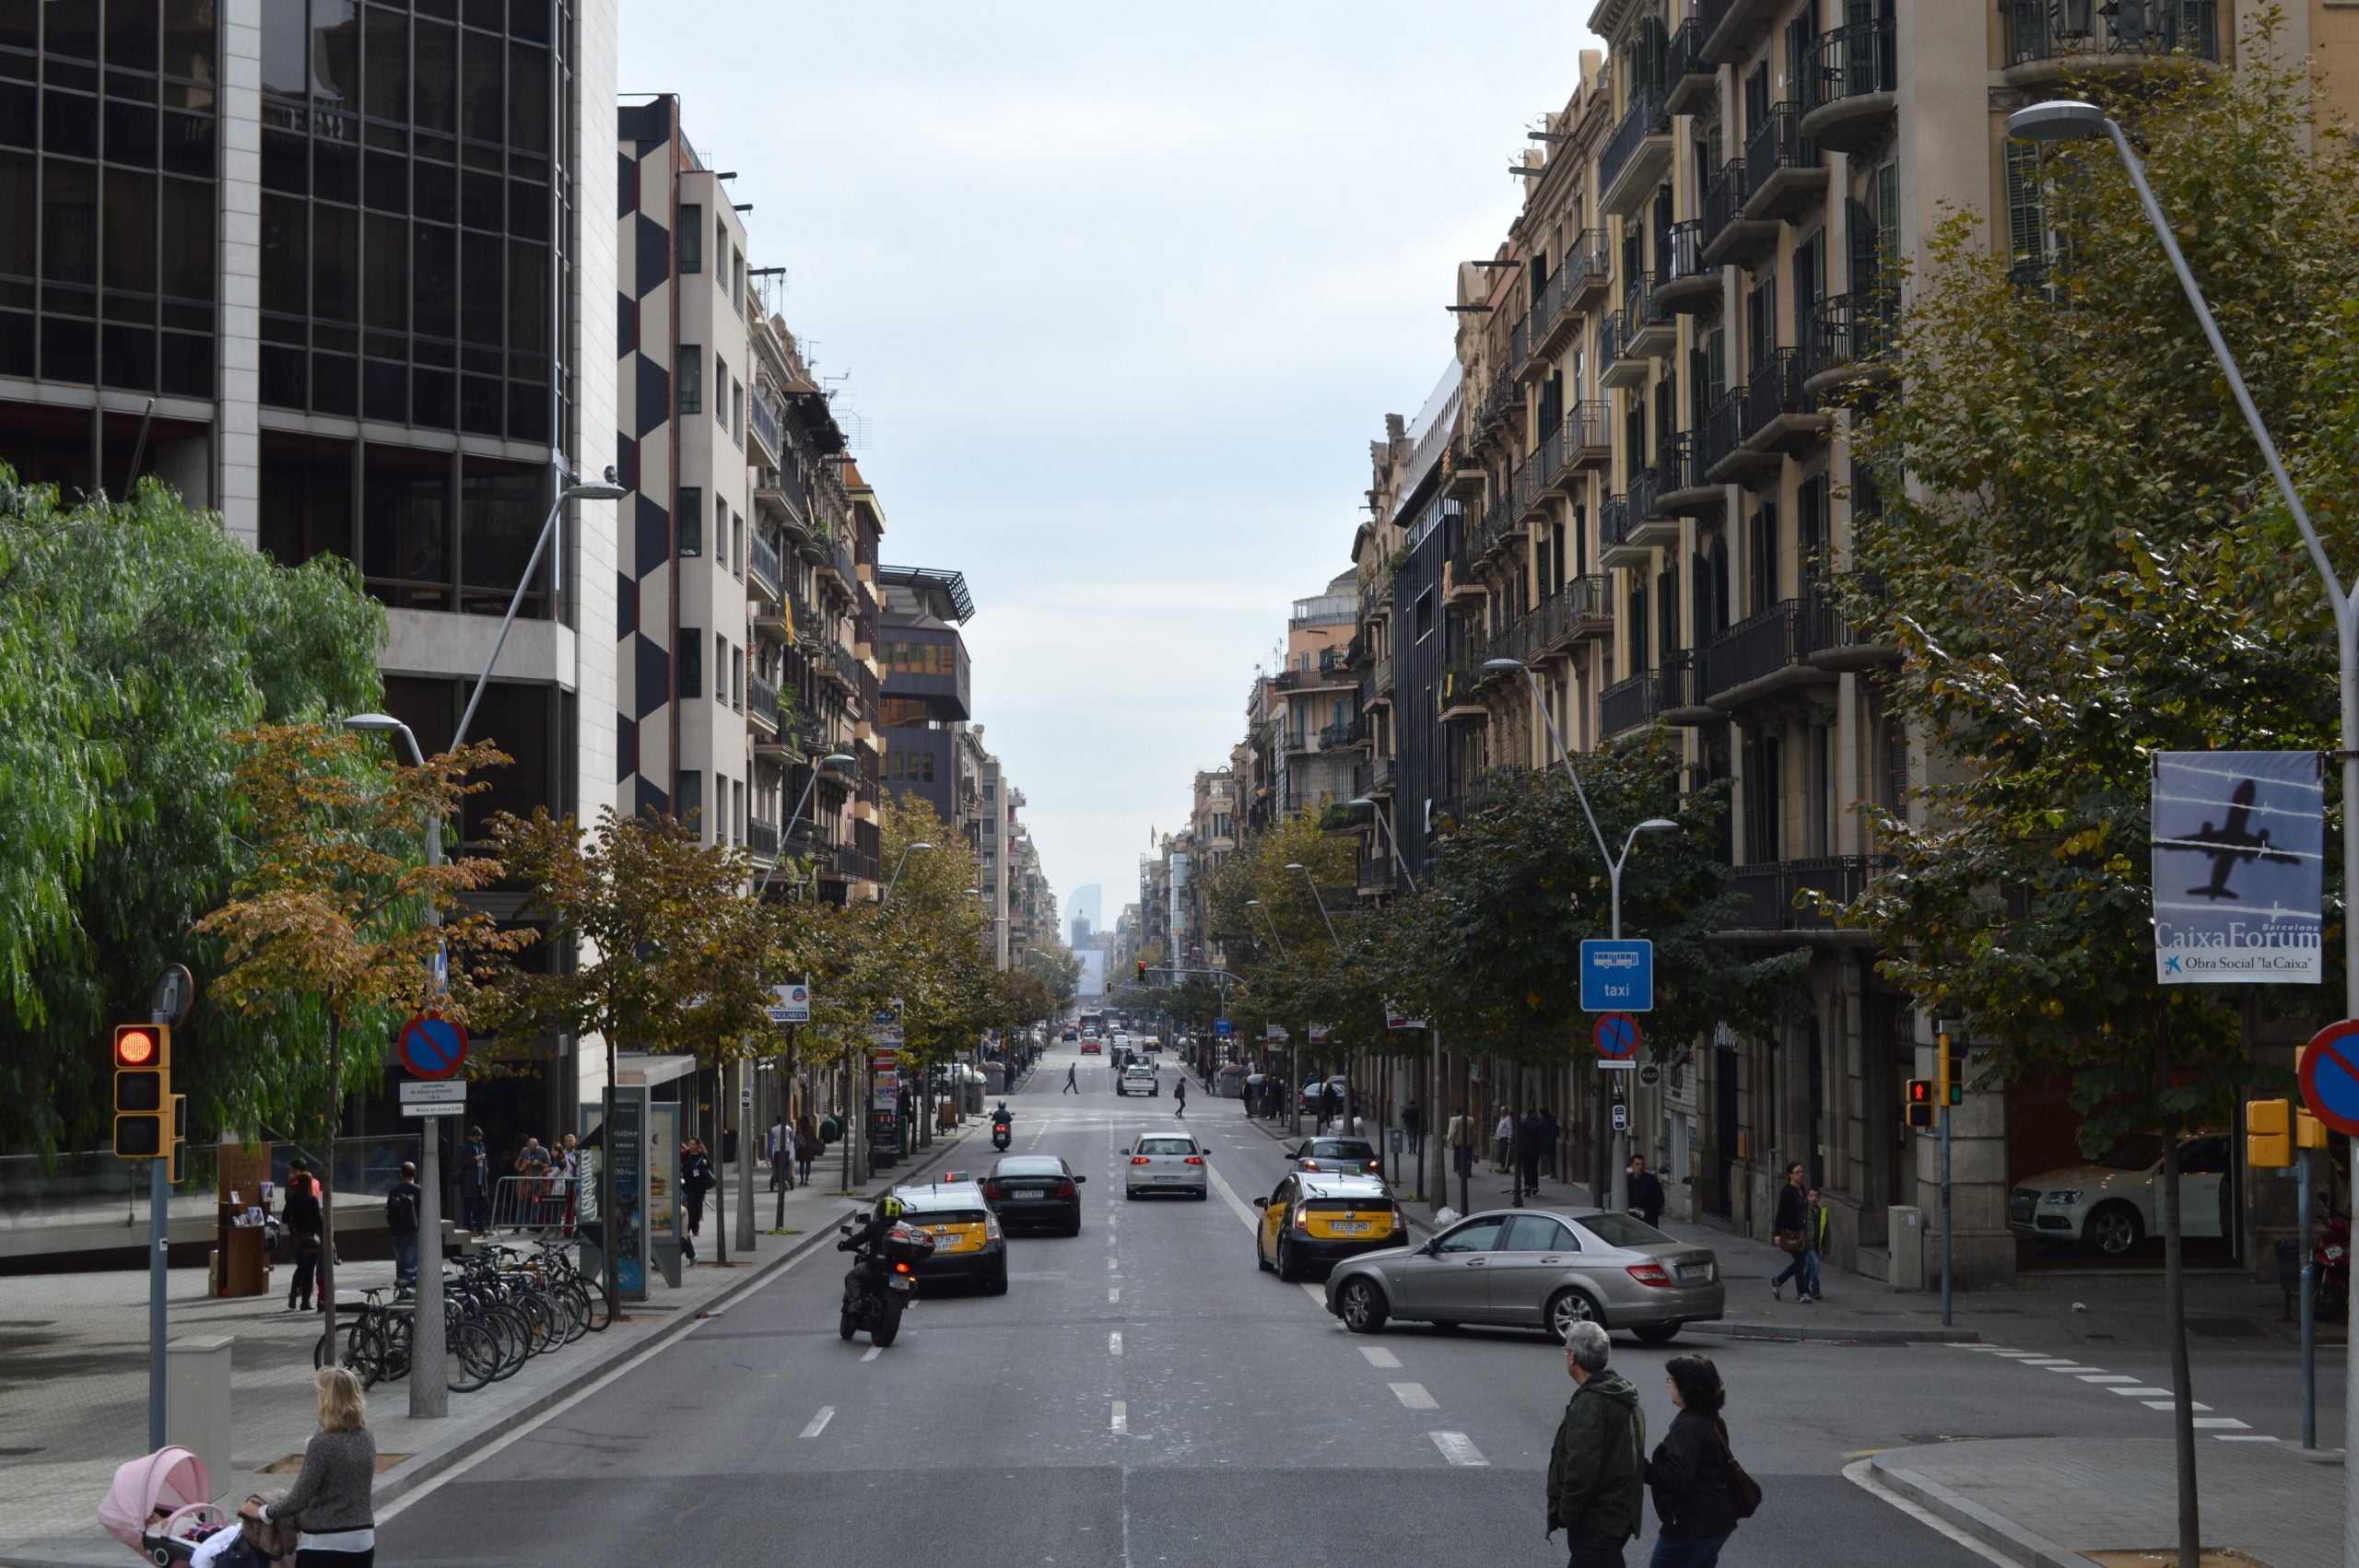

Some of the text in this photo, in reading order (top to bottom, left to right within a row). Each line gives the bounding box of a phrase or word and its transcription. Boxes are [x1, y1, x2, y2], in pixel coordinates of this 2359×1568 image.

[2262, 923, 2319, 931] Barcelona
[2155, 922, 2322, 949] CaixaForum
[2185, 957, 2216, 968] Obra
[2219, 957, 2254, 968] Social
[1604, 983, 1629, 996] taxi
